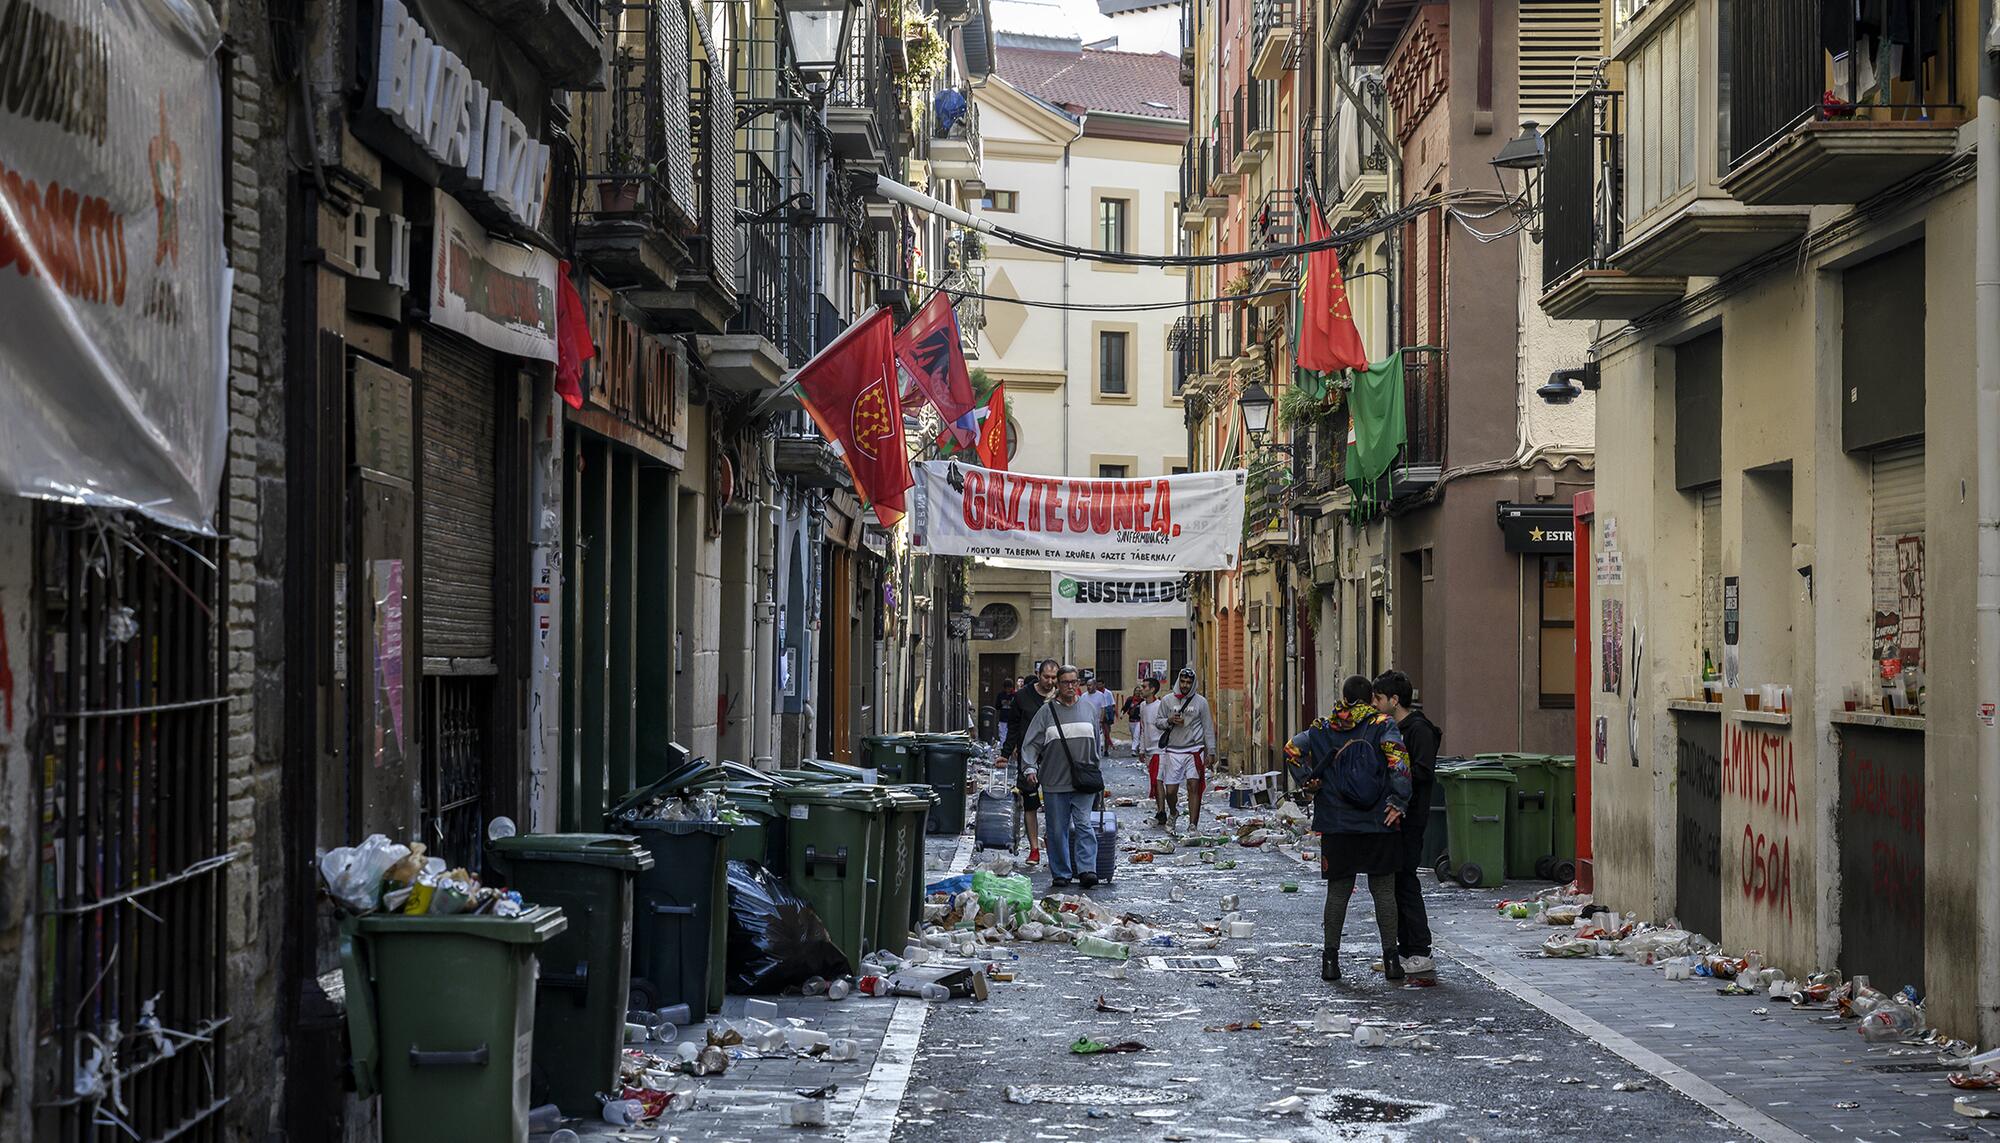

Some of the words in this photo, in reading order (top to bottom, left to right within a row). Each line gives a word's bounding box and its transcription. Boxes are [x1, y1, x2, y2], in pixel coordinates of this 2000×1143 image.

[1005, 547, 1040, 556] TABERNA
[1045, 549, 1061, 557] ETA
[1065, 549, 1096, 560] IRUÑEA
[1100, 552, 1126, 560] GAZTE
[1546, 531, 1575, 541] ESTR
[1722, 723, 1799, 825] AMNISTIA
[1741, 823, 1793, 927] OSOA
